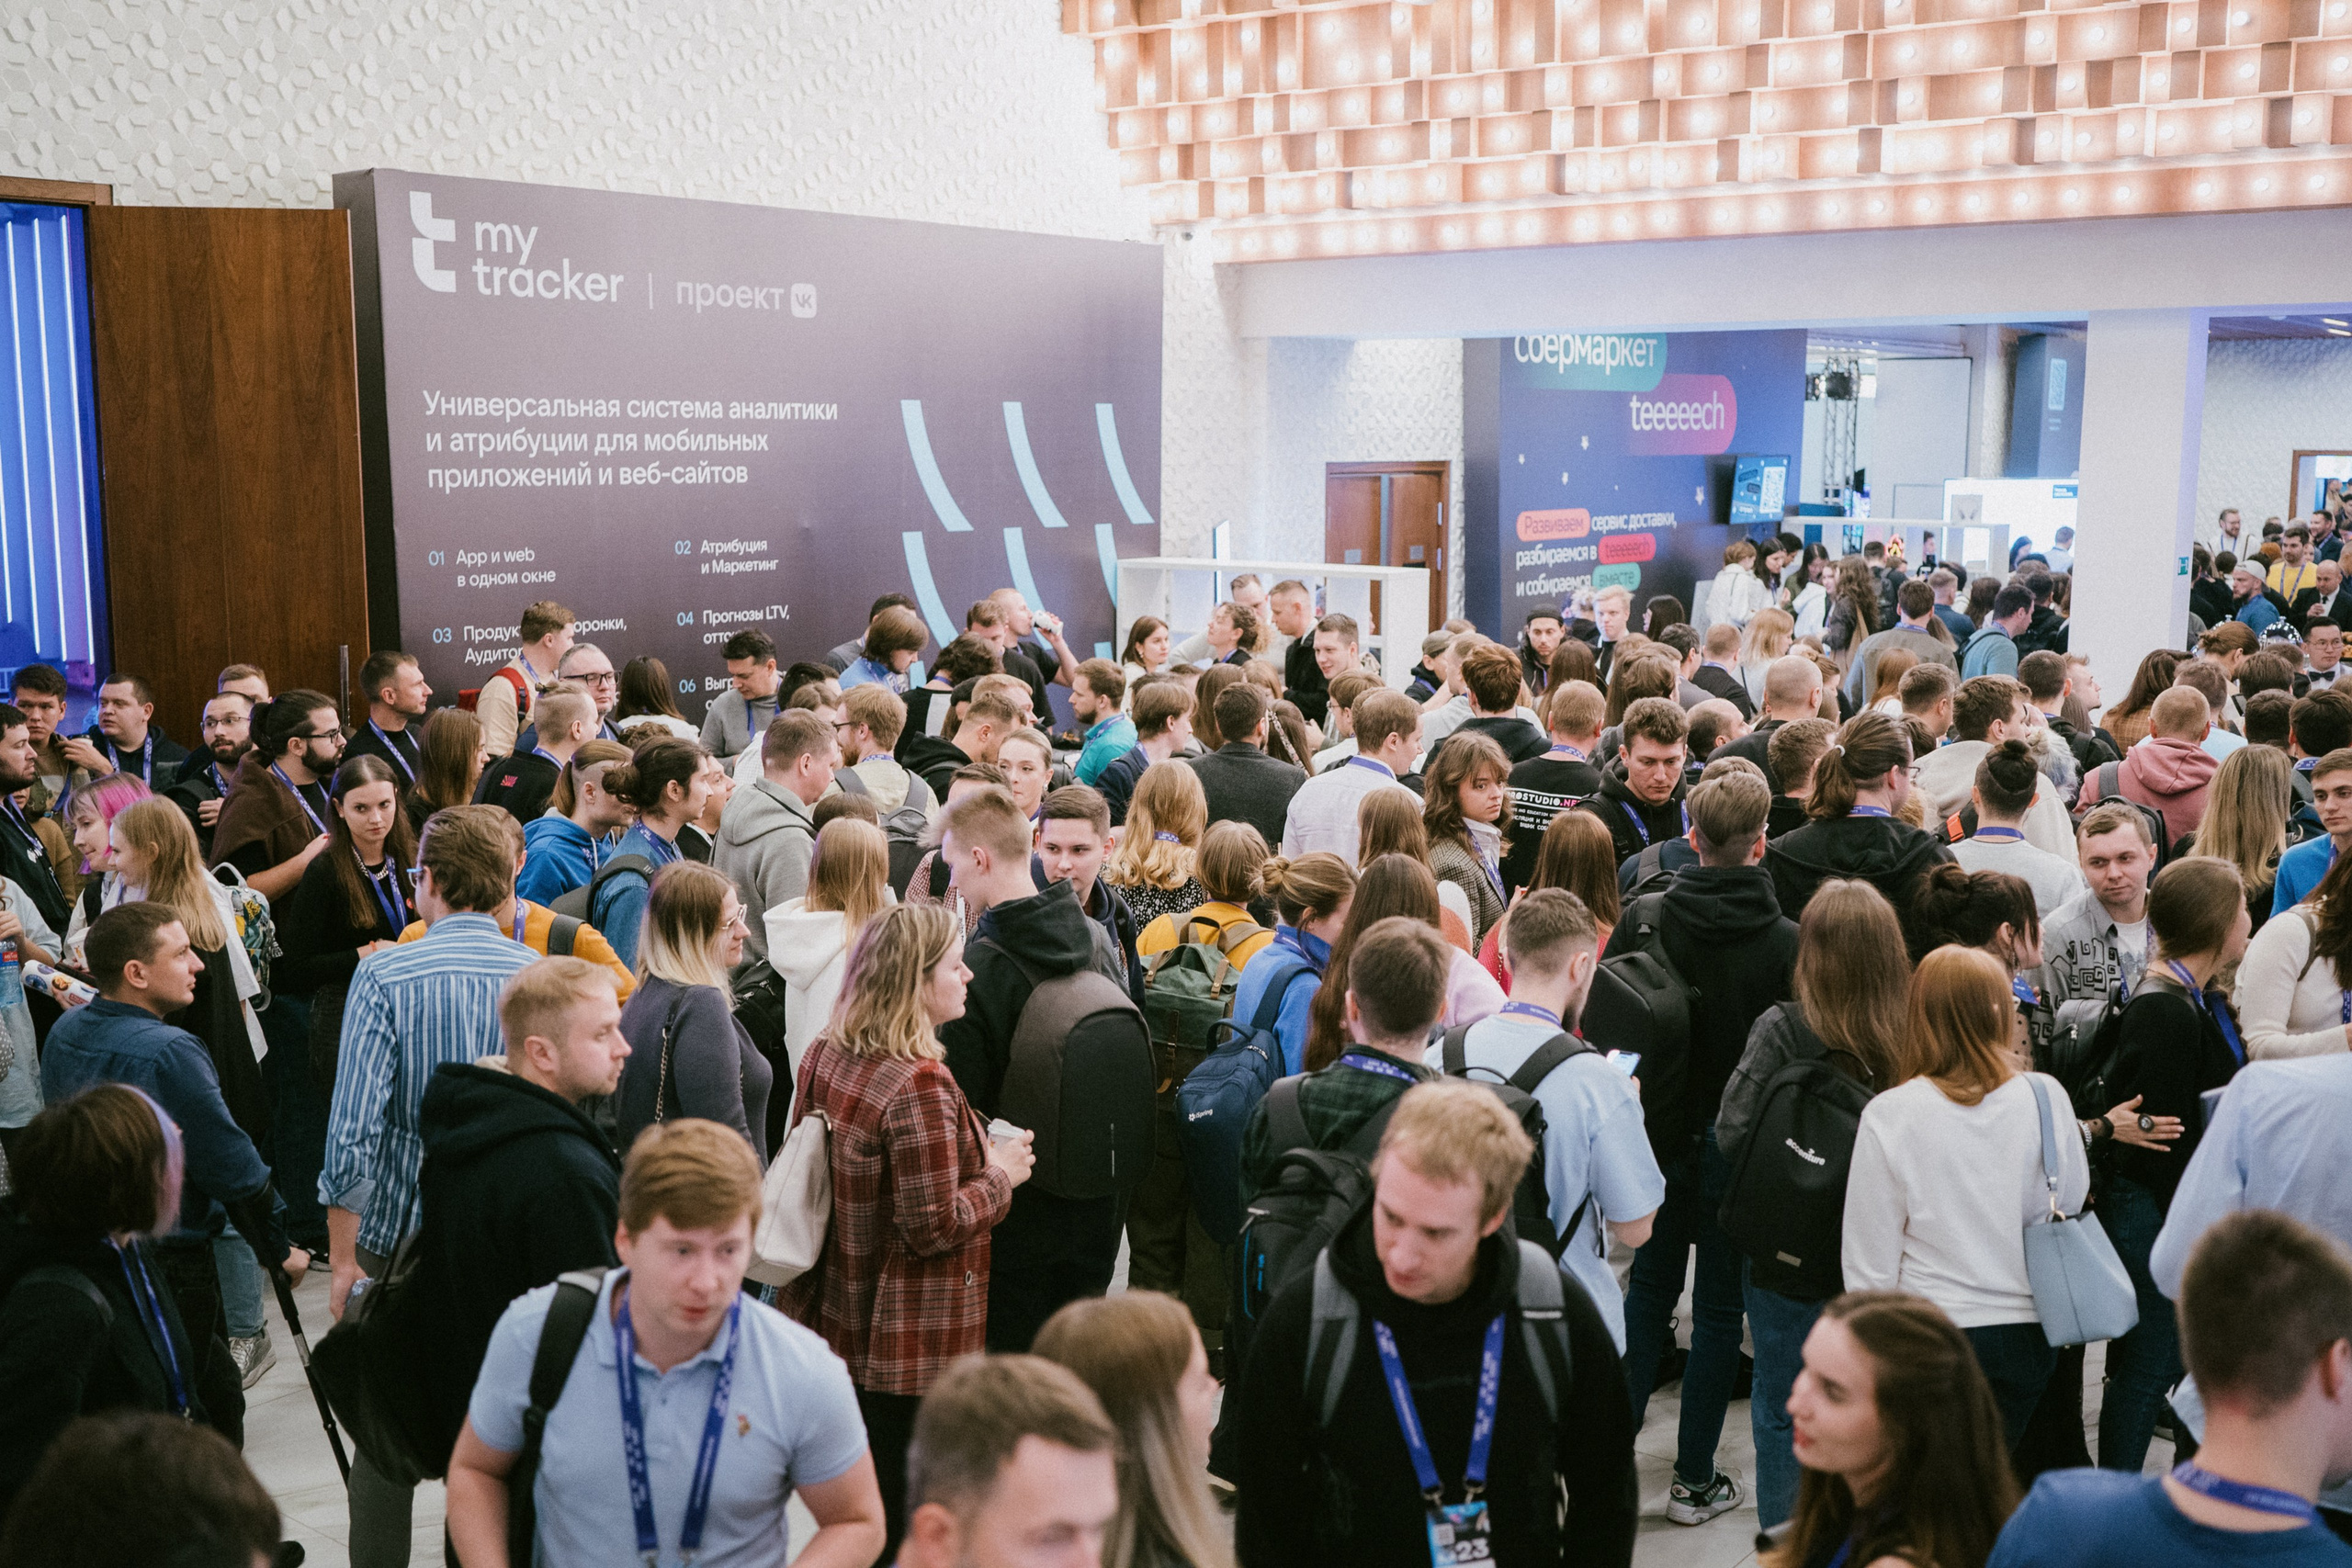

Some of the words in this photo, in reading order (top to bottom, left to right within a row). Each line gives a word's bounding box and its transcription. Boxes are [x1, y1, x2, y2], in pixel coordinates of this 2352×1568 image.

[475, 221, 538, 265] my
[472, 258, 625, 302] tracker
[676, 281, 785, 313] проект
[423, 389, 620, 423] Универсальная
[627, 400, 723, 418] система
[729, 401, 838, 420] аналитики
[426, 433, 442, 452] и
[449, 427, 588, 457] атрибуции
[594, 433, 638, 456] для
[644, 428, 769, 451] мобильных
[428, 461, 591, 494] приложений
[598, 467, 613, 485] и
[619, 460, 749, 485] веб-сайтов
[1524, 515, 1584, 535] Развиваем
[1591, 515, 1627, 534] сервис
[428, 550, 445, 566] 01
[456, 549, 488, 568] App
[492, 551, 501, 563] и
[503, 547, 535, 562] web
[674, 540, 692, 555] 02
[700, 538, 768, 557] Атрибуция
[1516, 543, 1589, 570] разбираемся
[1589, 545, 1598, 560] в
[701, 562, 709, 574] и
[712, 558, 779, 576] Маркетинг
[1599, 570, 1635, 587] вместе
[458, 575, 466, 587] в
[469, 572, 518, 589] одном
[522, 570, 557, 583] окне
[677, 611, 694, 626] 04
[703, 609, 763, 627] Прогнозы
[765, 604, 790, 620] LTV,
[433, 627, 452, 644] 03
[463, 625, 521, 644] Продук
[573, 618, 628, 636] оронки,
[703, 631, 737, 645] отто
[465, 646, 523, 666] Аудитор
[679, 678, 696, 694] 06
[705, 676, 734, 692] Выгр
[1785, 1138, 1826, 1166] accenture
